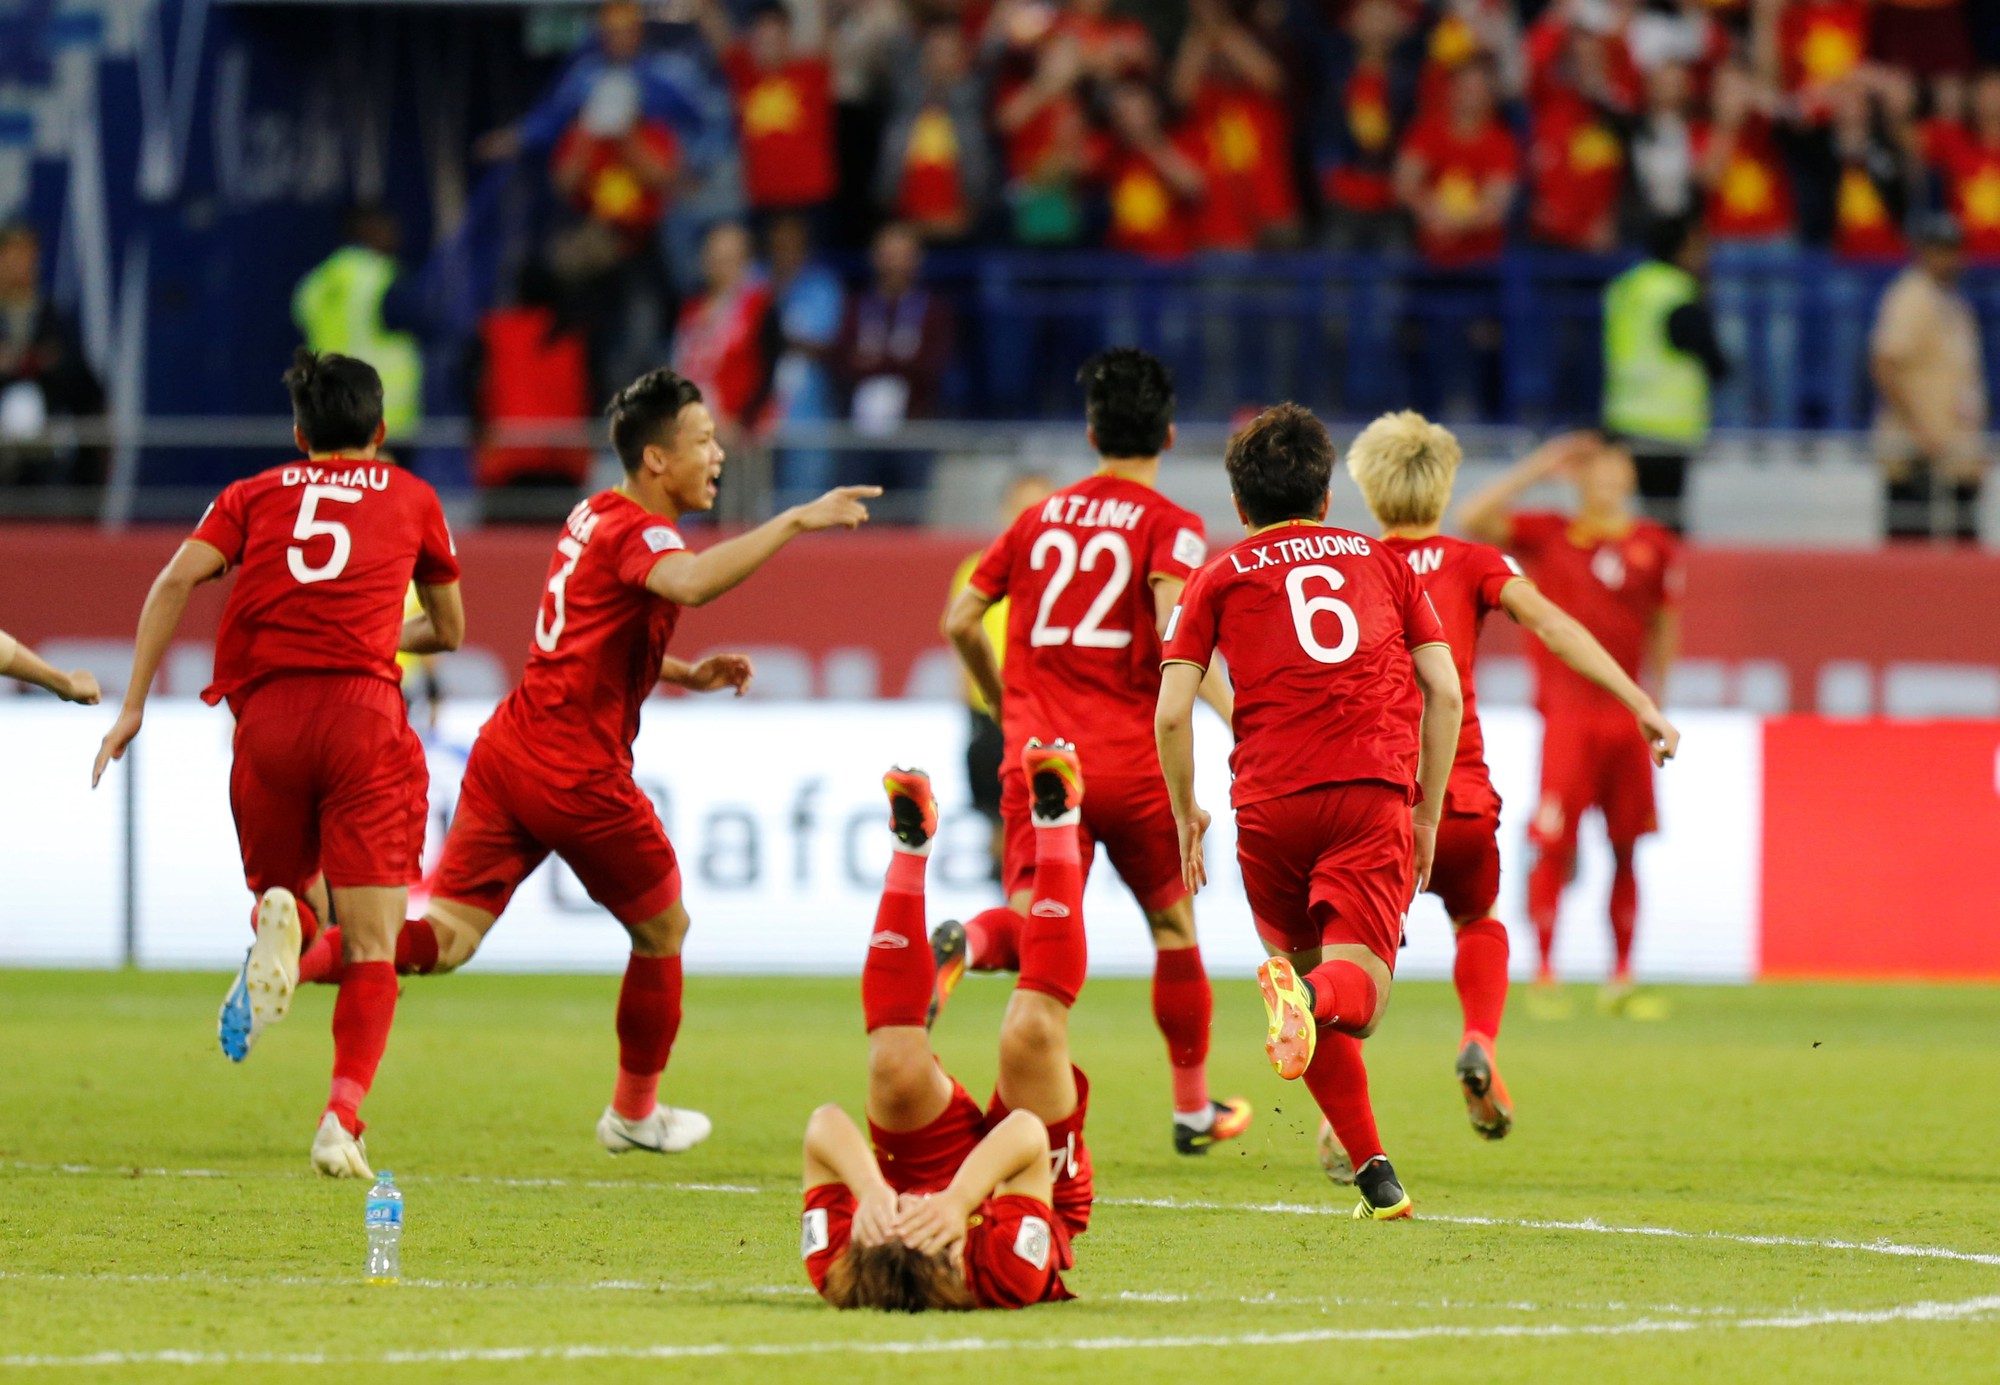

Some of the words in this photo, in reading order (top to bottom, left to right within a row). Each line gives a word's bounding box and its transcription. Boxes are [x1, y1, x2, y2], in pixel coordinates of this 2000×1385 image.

[282, 466, 389, 491] D.V.HAU
[287, 483, 363, 584] 5
[1230, 535, 1371, 573] L.X.TRUONG
[535, 536, 583, 652] 3
[1030, 528, 1133, 648] 22
[1285, 564, 1359, 664] 6
